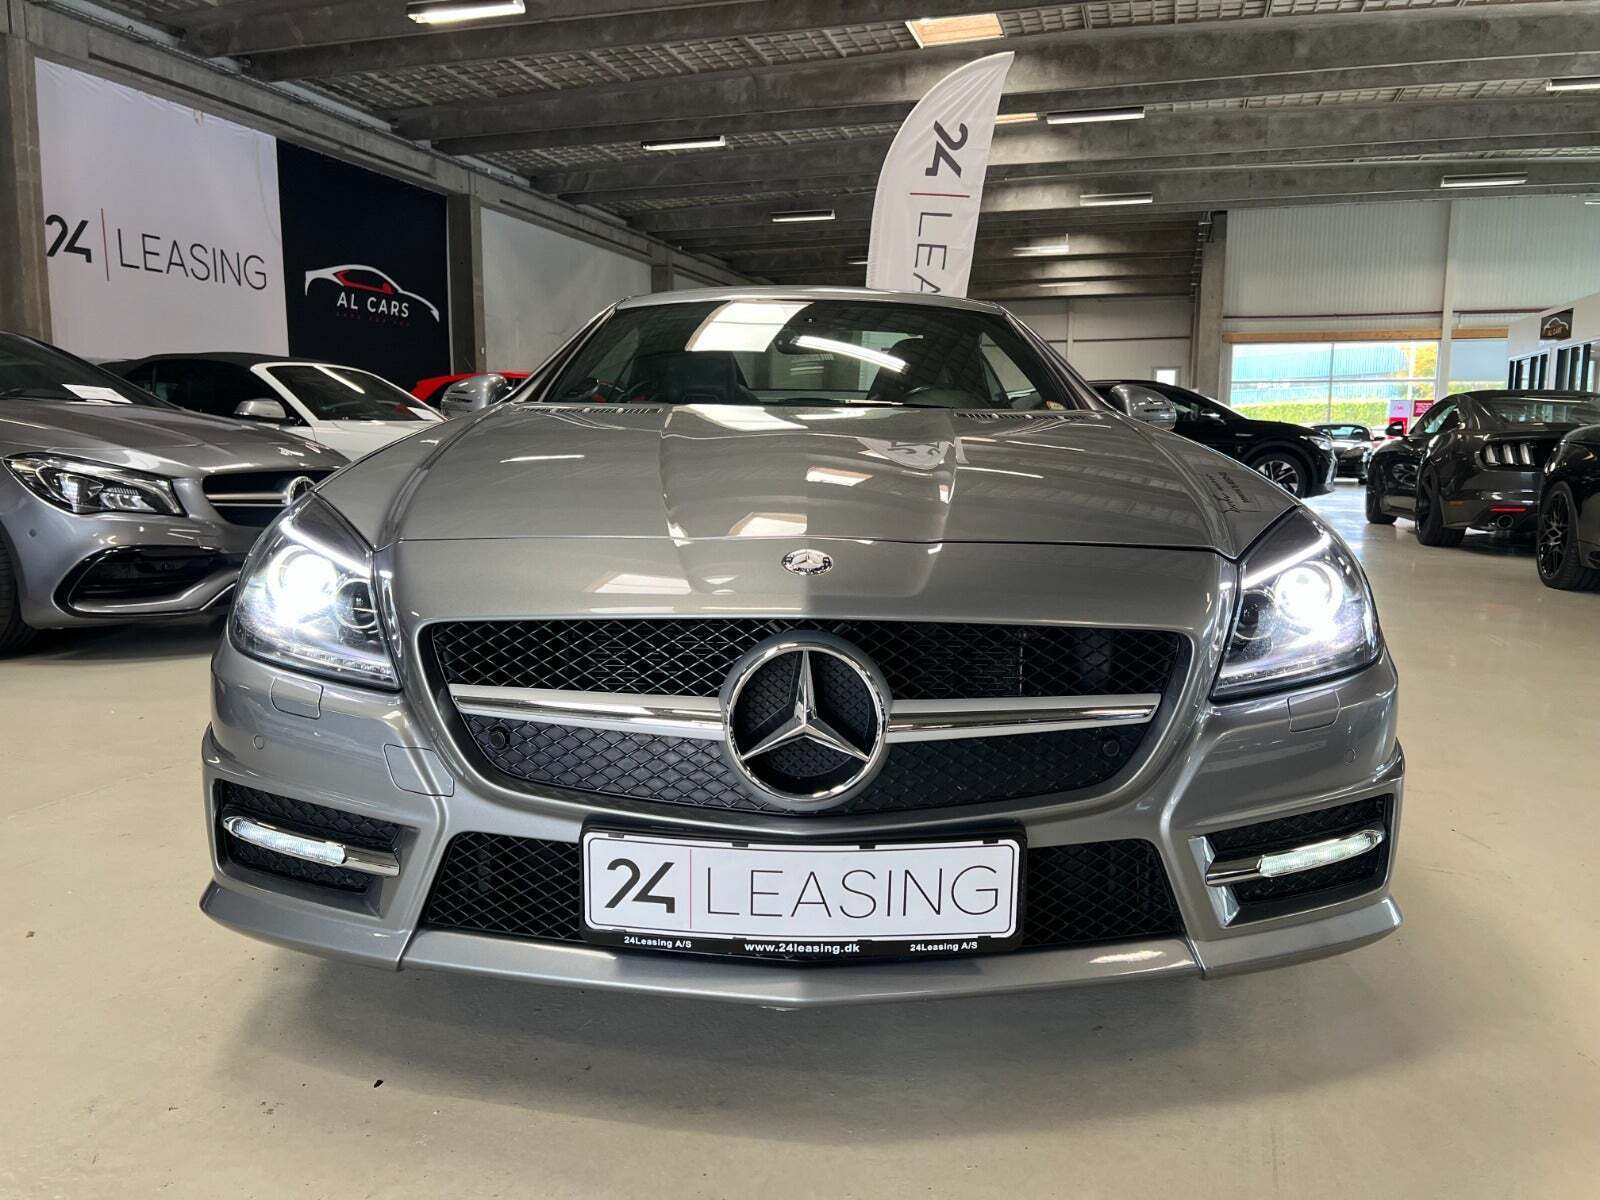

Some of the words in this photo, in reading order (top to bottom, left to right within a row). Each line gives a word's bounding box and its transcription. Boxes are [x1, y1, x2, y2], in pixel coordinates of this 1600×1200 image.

[925, 120, 969, 178] 24
[45, 214, 92, 263] 24
[117, 228, 267, 290] LEASING
[337, 291, 359, 310] AL
[367, 297, 409, 318] CARS
[604, 858, 676, 914] 24
[707, 865, 999, 919] LEASING
[623, 936, 673, 948] 24Leasing
[675, 939, 692, 948] A/S
[744, 942, 860, 954] www.24leasing.dk
[910, 941, 959, 952] 24Leasing
[961, 941, 978, 951] A/S
